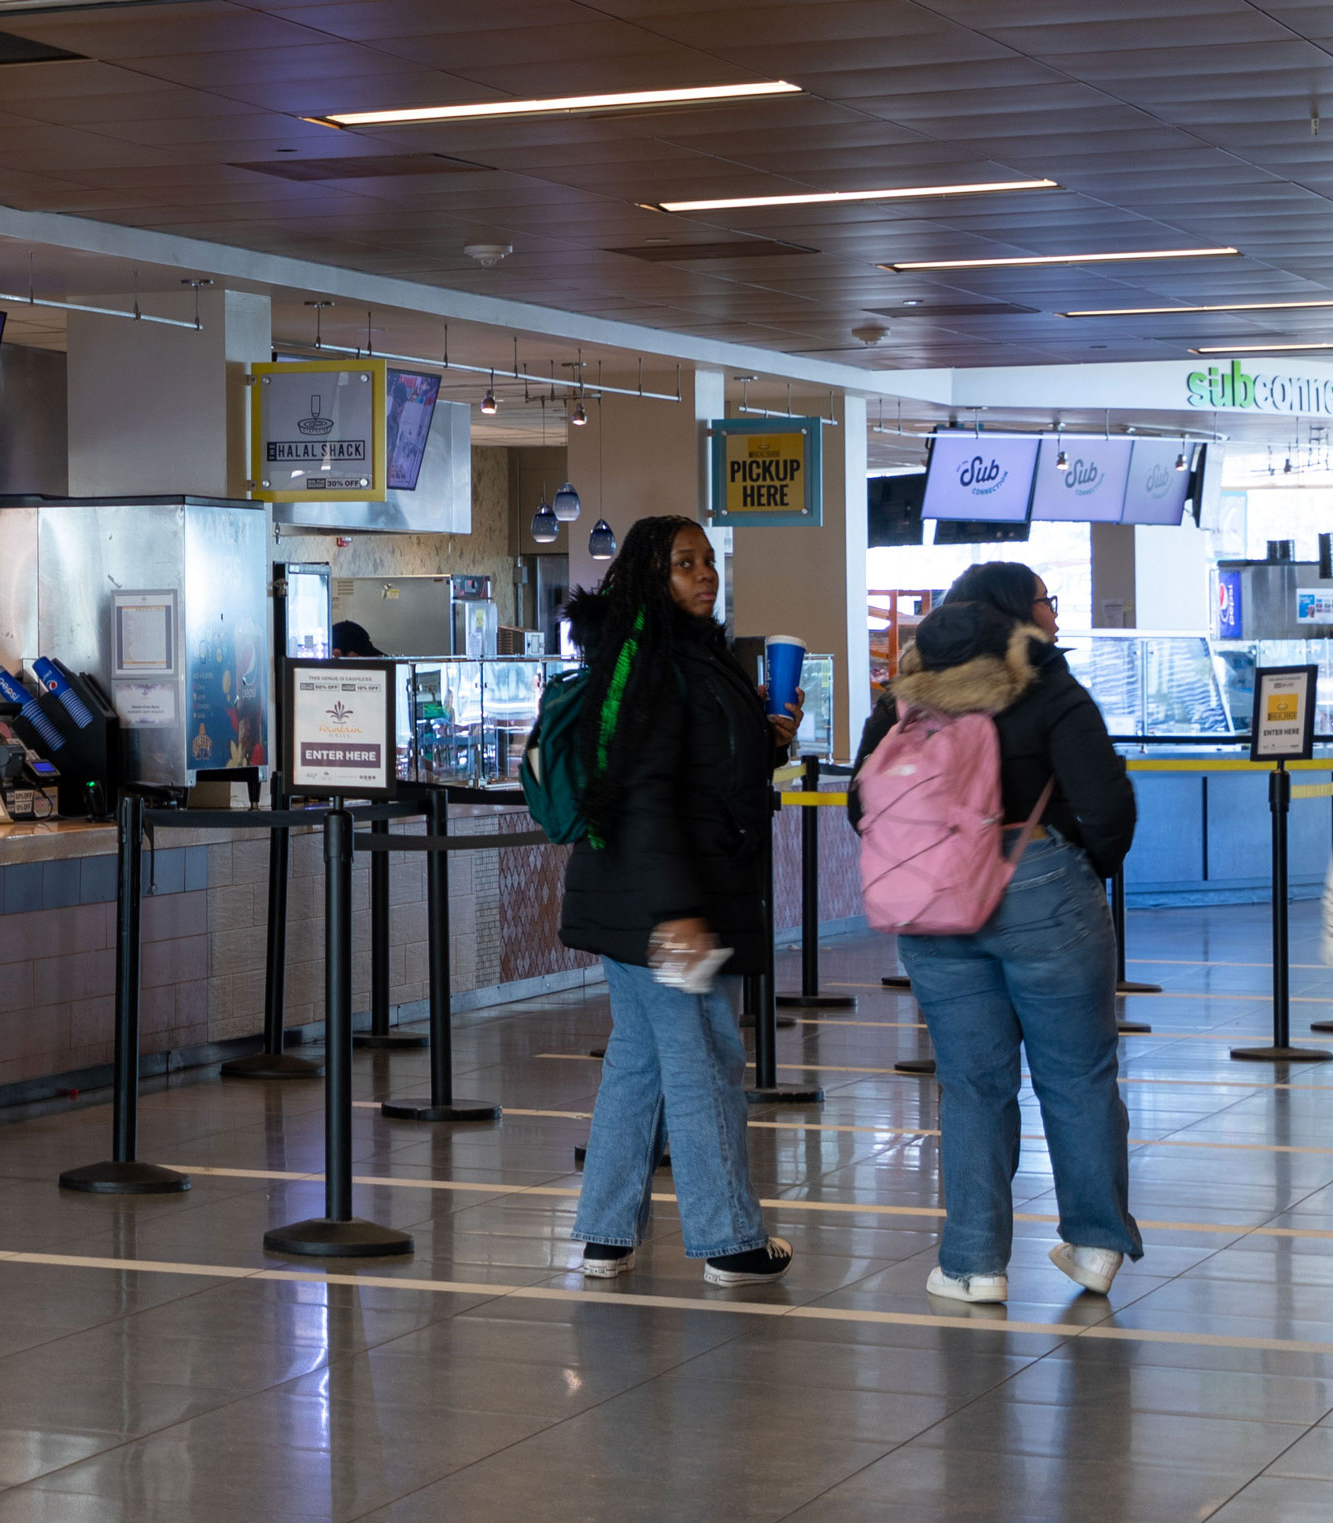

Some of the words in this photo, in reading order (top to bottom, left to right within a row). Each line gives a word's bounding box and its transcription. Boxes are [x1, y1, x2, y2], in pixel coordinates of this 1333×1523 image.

[278, 444, 317, 458] HALAL
[321, 443, 362, 457] SHACK
[730, 459, 800, 483] PICKUP
[960, 456, 999, 487] Sub
[972, 470, 1008, 495] CONNECTION
[1065, 459, 1097, 488] Sub
[743, 484, 789, 507] HERE
[1227, 584, 1235, 626] pepsi
[1263, 728, 1283, 736] ENTER
[1284, 727, 1300, 735] HERE
[305, 749, 343, 760] ENTER
[346, 751, 377, 761] HERE
